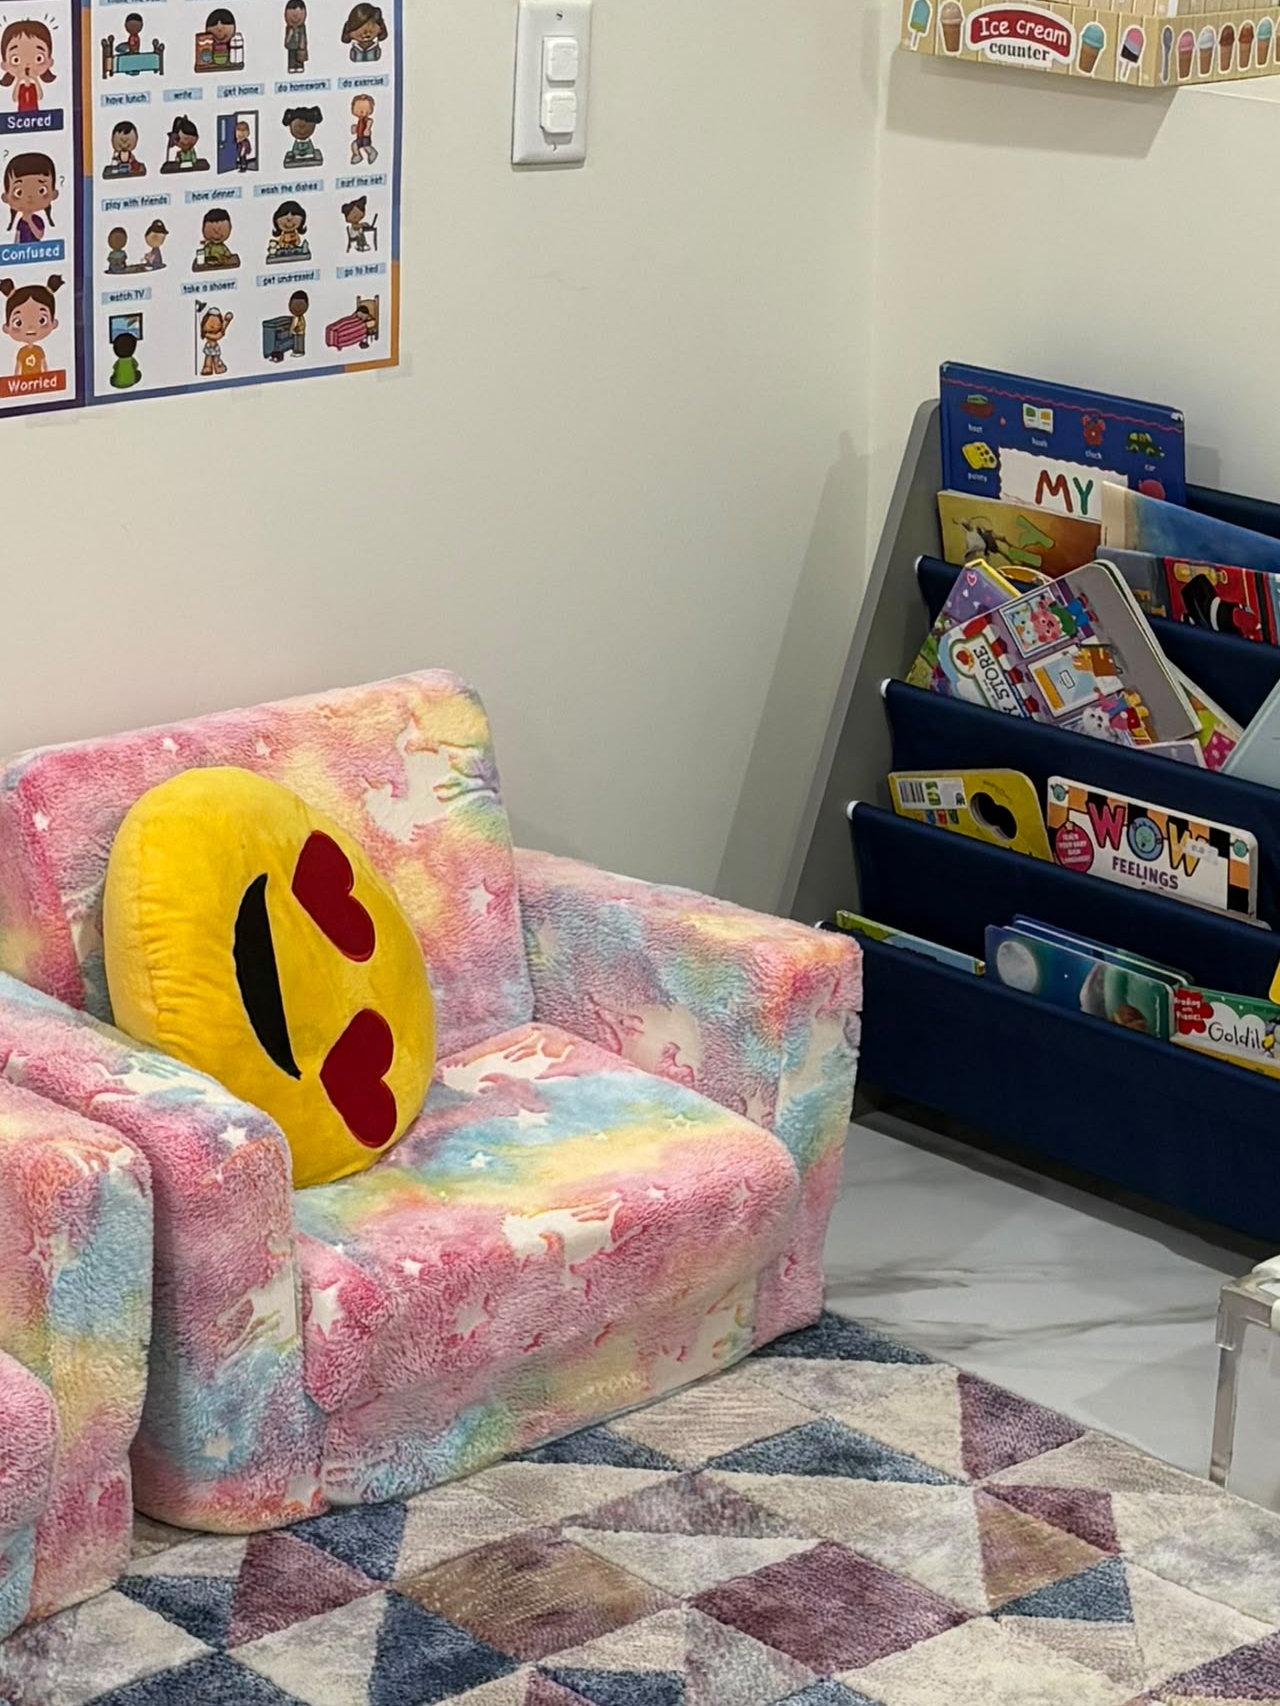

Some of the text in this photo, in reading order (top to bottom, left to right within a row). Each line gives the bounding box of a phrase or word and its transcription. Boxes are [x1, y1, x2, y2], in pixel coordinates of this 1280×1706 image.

[978, 16, 1068, 46] Ice cream
[989, 41, 1050, 62] counter
[7, 114, 51, 129] Scared
[1, 245, 59, 261] Confused
[8, 377, 57, 392] Worried
[1034, 469, 1094, 515] MY
[973, 645, 1010, 701] STORE
[1086, 801, 1201, 877] WOW
[1112, 856, 1179, 890] FEELINGS
